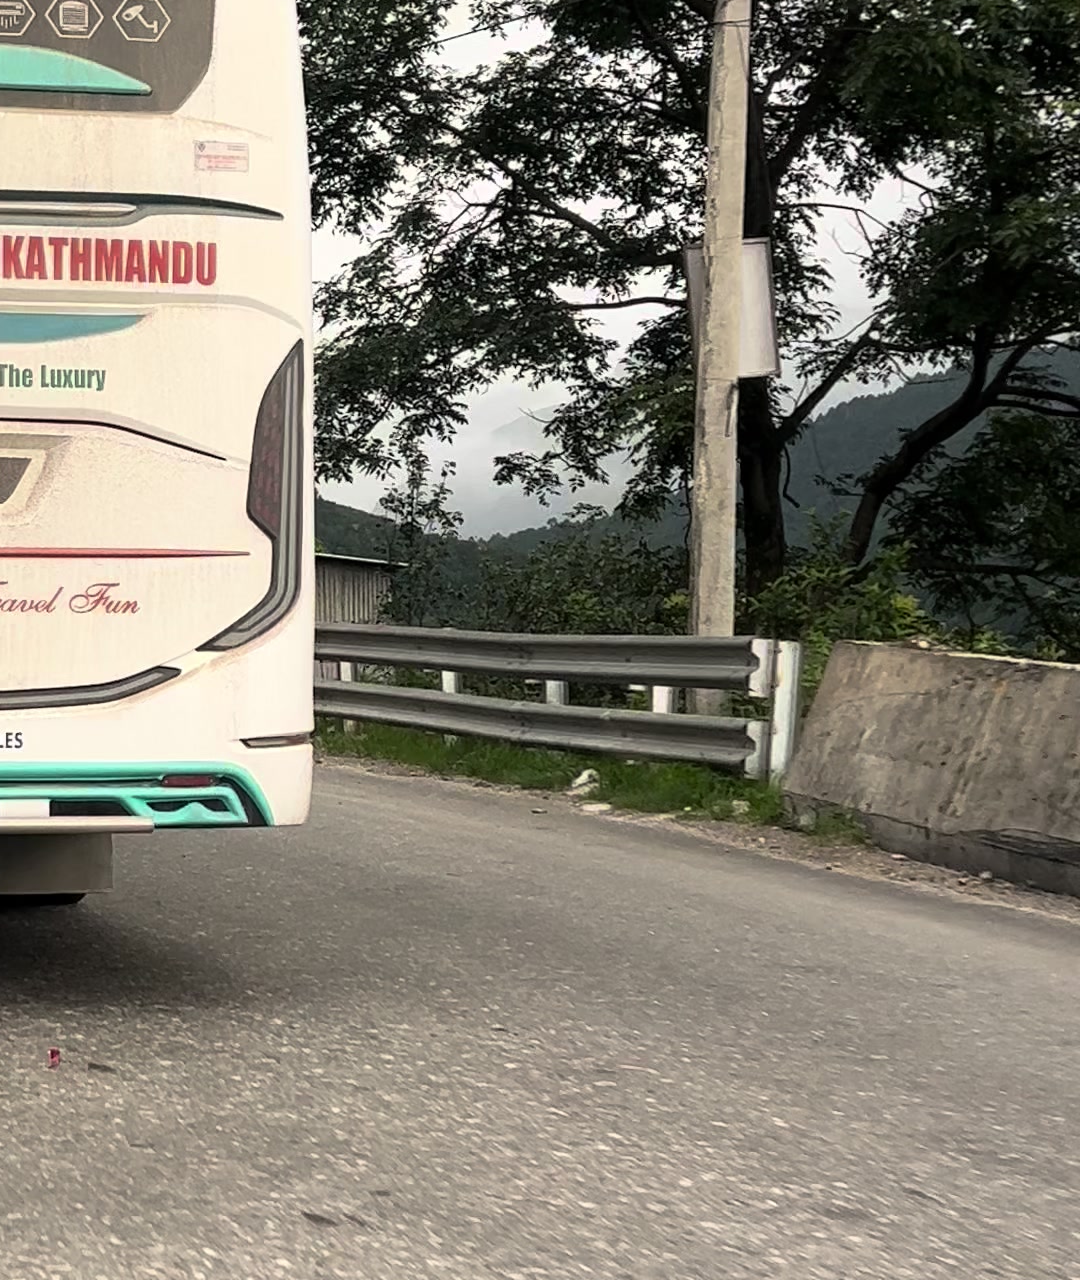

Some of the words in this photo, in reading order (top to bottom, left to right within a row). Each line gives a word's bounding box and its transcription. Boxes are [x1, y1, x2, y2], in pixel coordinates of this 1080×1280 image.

[2, 235, 218, 286] KATHMANDU
[40, 364, 107, 392] Luxury
[68, 582, 141, 615] Fun
